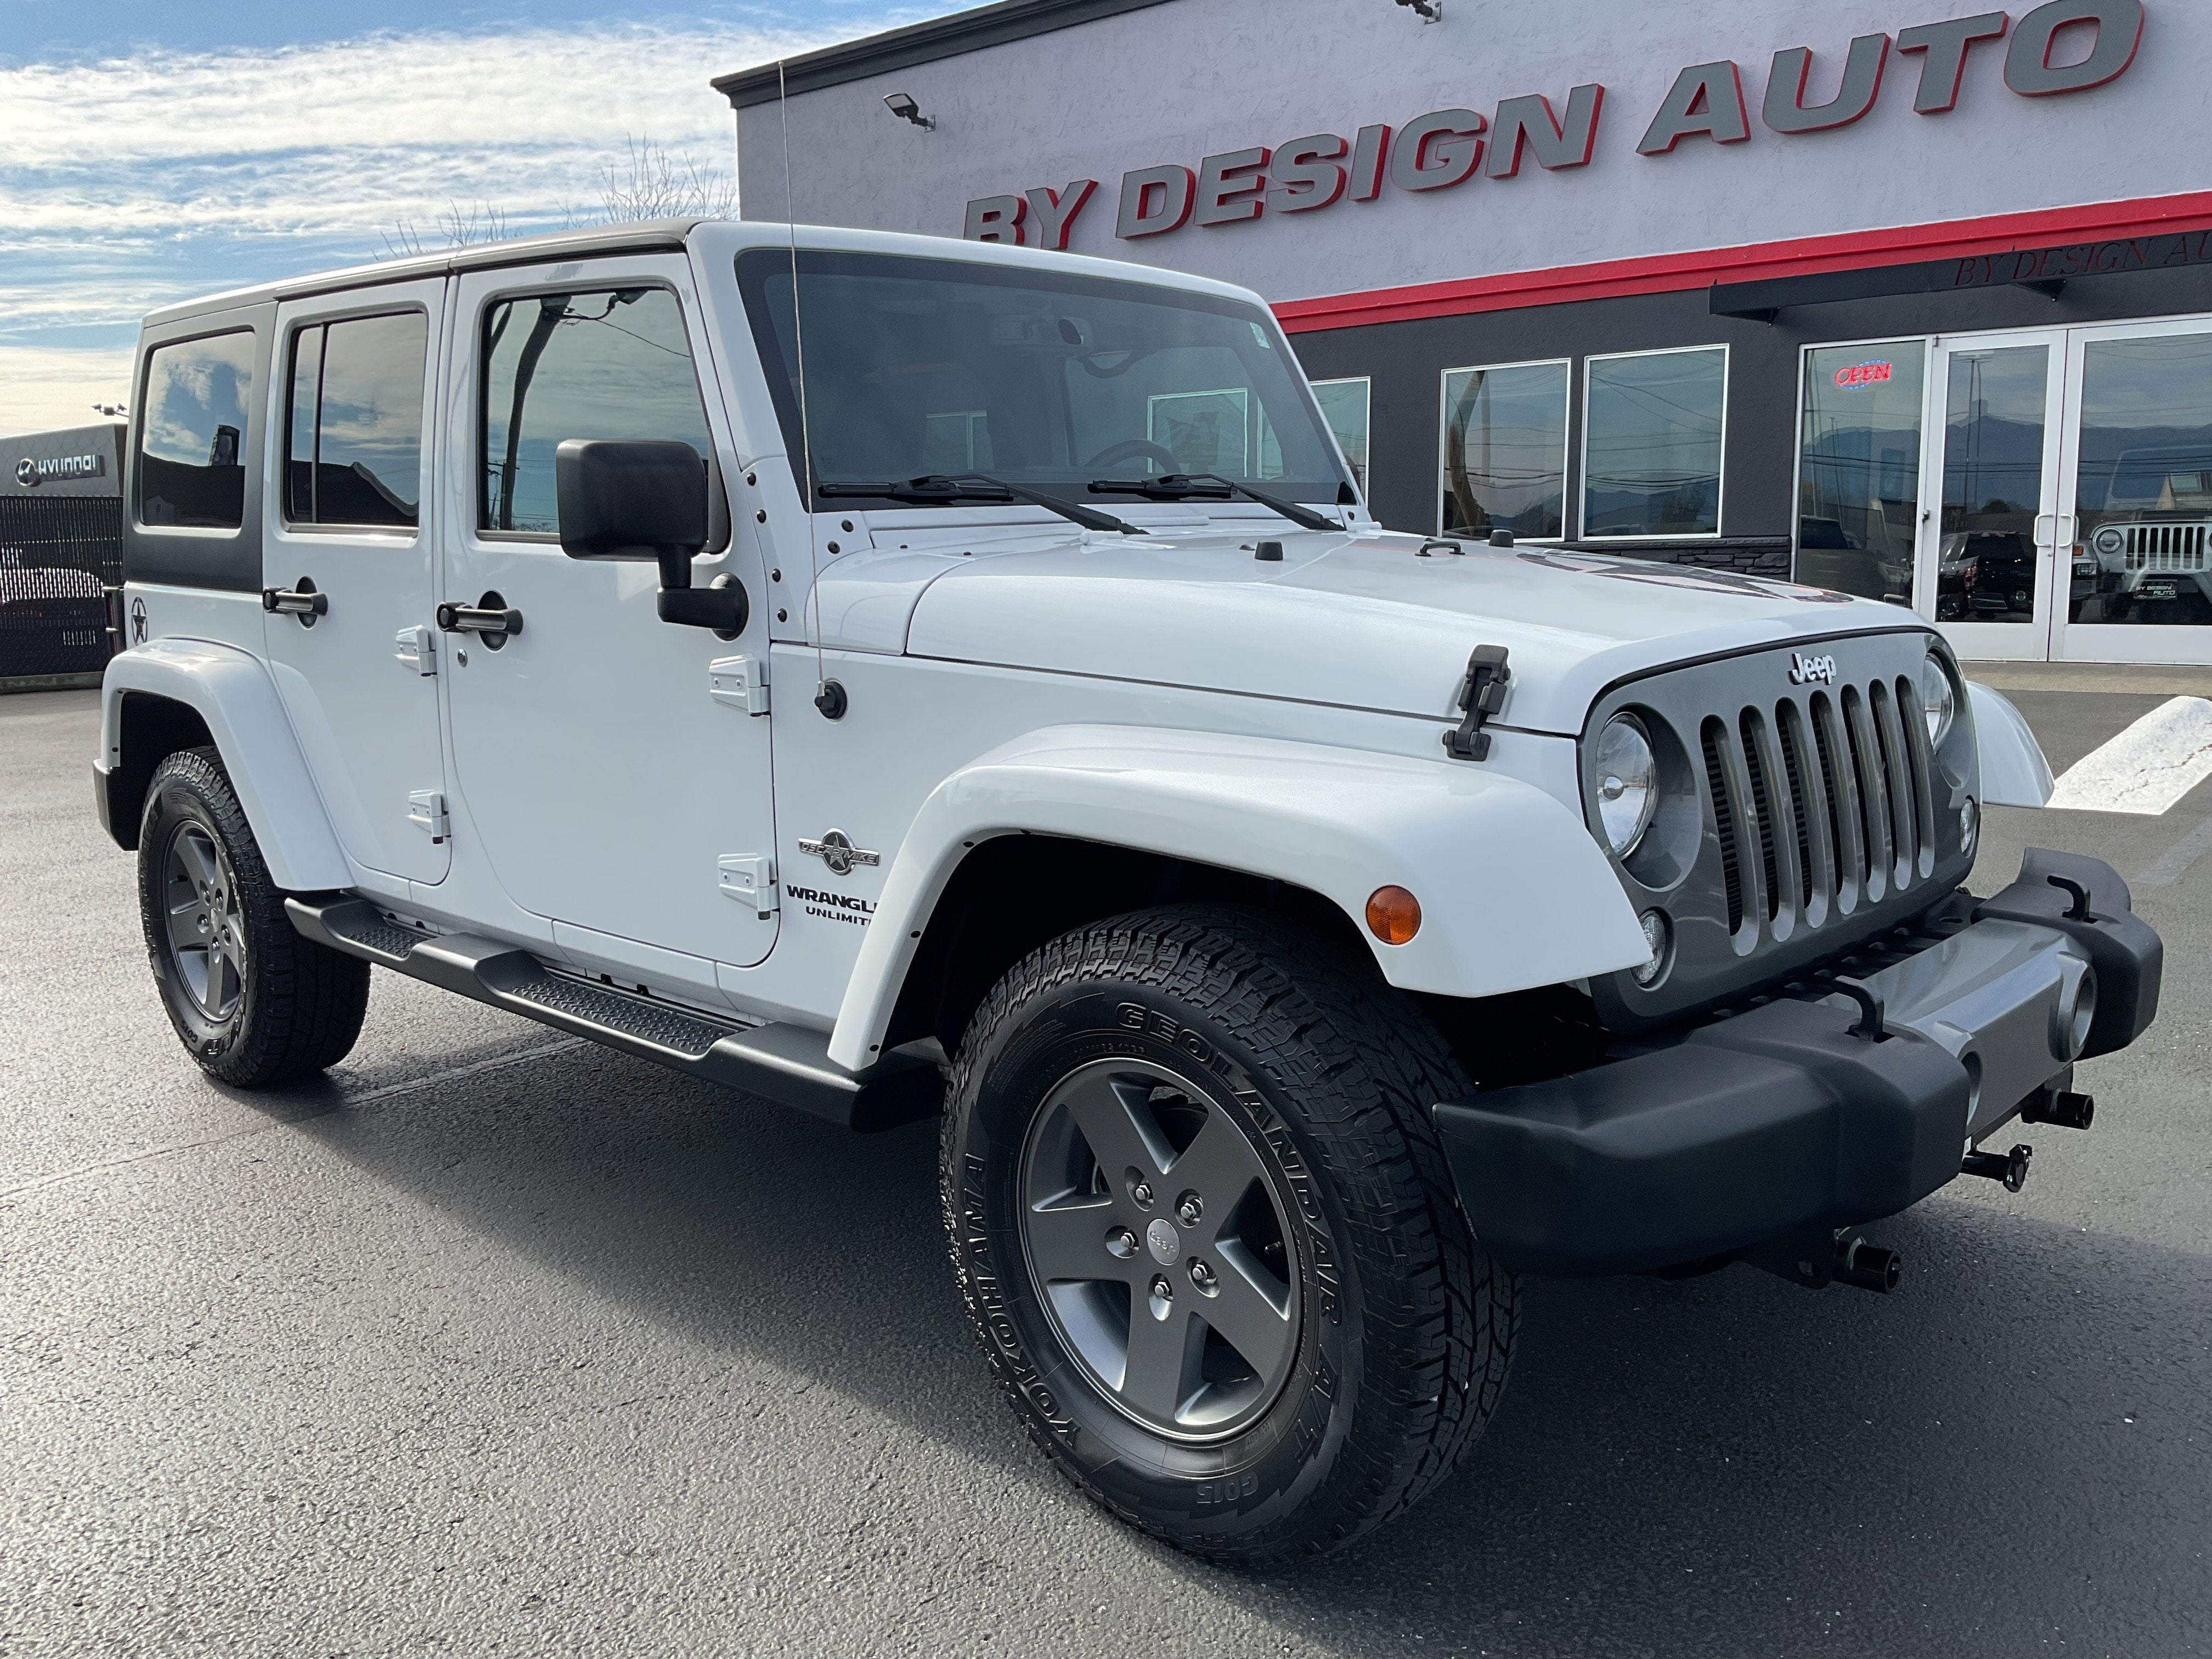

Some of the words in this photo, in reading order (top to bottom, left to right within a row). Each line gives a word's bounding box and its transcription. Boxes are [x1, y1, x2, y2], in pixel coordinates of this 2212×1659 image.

[964, 179, 1098, 249] BY
[1115, 83, 1604, 239] DESIGN
[1635, 0, 2145, 156] AUTO
[1954, 256, 2005, 286] BY
[2011, 238, 2153, 279] DESIGN
[1835, 364, 1892, 385] OPEN
[38, 455, 97, 475] HYUNDAI
[1787, 652, 1837, 685] Jeep
[801, 843, 842, 859] OSCAR
[843, 851, 876, 863] MIKE
[787, 884, 878, 913] WRANGL
[806, 906, 871, 927] UNLIMIT
[1115, 1002, 1342, 1327] GEOLANDAR
[964, 1153, 1080, 1449] YOKOHAMA
